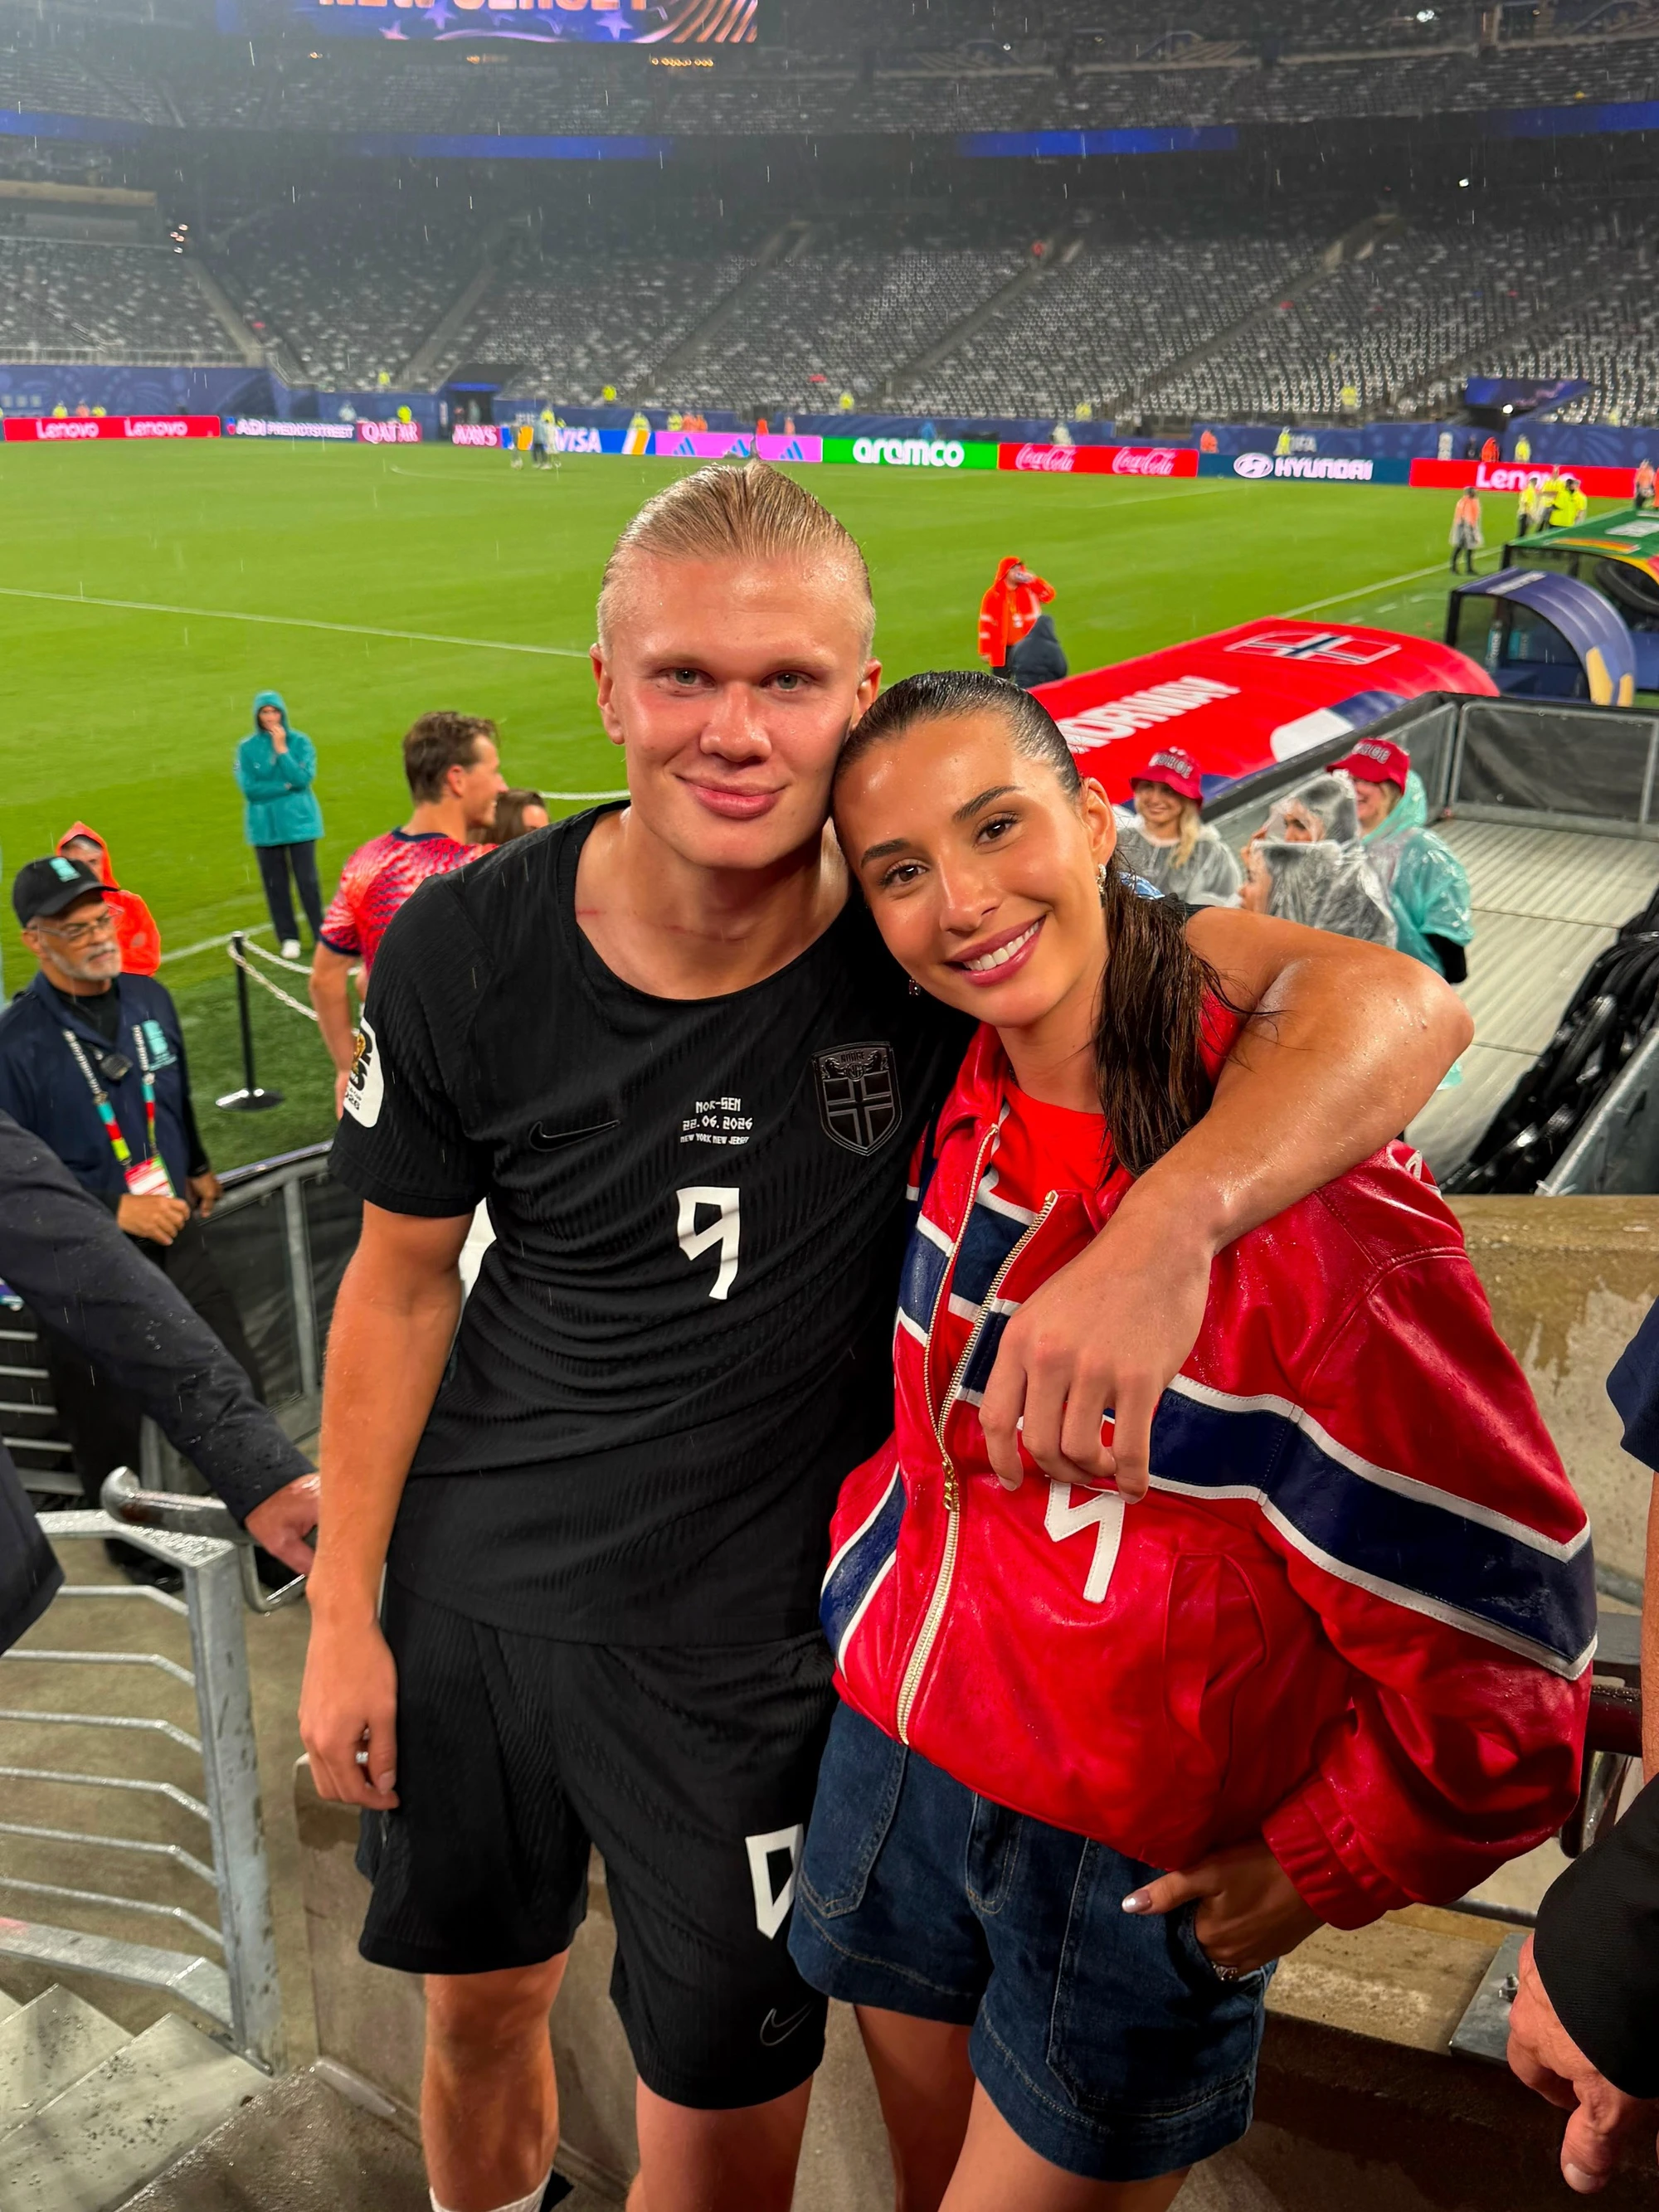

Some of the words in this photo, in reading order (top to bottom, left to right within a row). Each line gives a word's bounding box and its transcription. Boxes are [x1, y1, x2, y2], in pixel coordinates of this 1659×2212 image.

[36, 419, 99, 438] Lenovo
[124, 417, 187, 437] Lenovo
[362, 421, 418, 444] QATAR
[555, 427, 601, 453] VISA
[853, 438, 965, 467] aramco
[1274, 458, 1373, 481] HYUNDAI
[695, 1097, 742, 1114] NOR-SEN
[680, 1134, 695, 1143] NEW
[695, 1133, 712, 1144] YORK
[713, 1135, 727, 1145] NEW
[676, 1186, 740, 1300] 9
